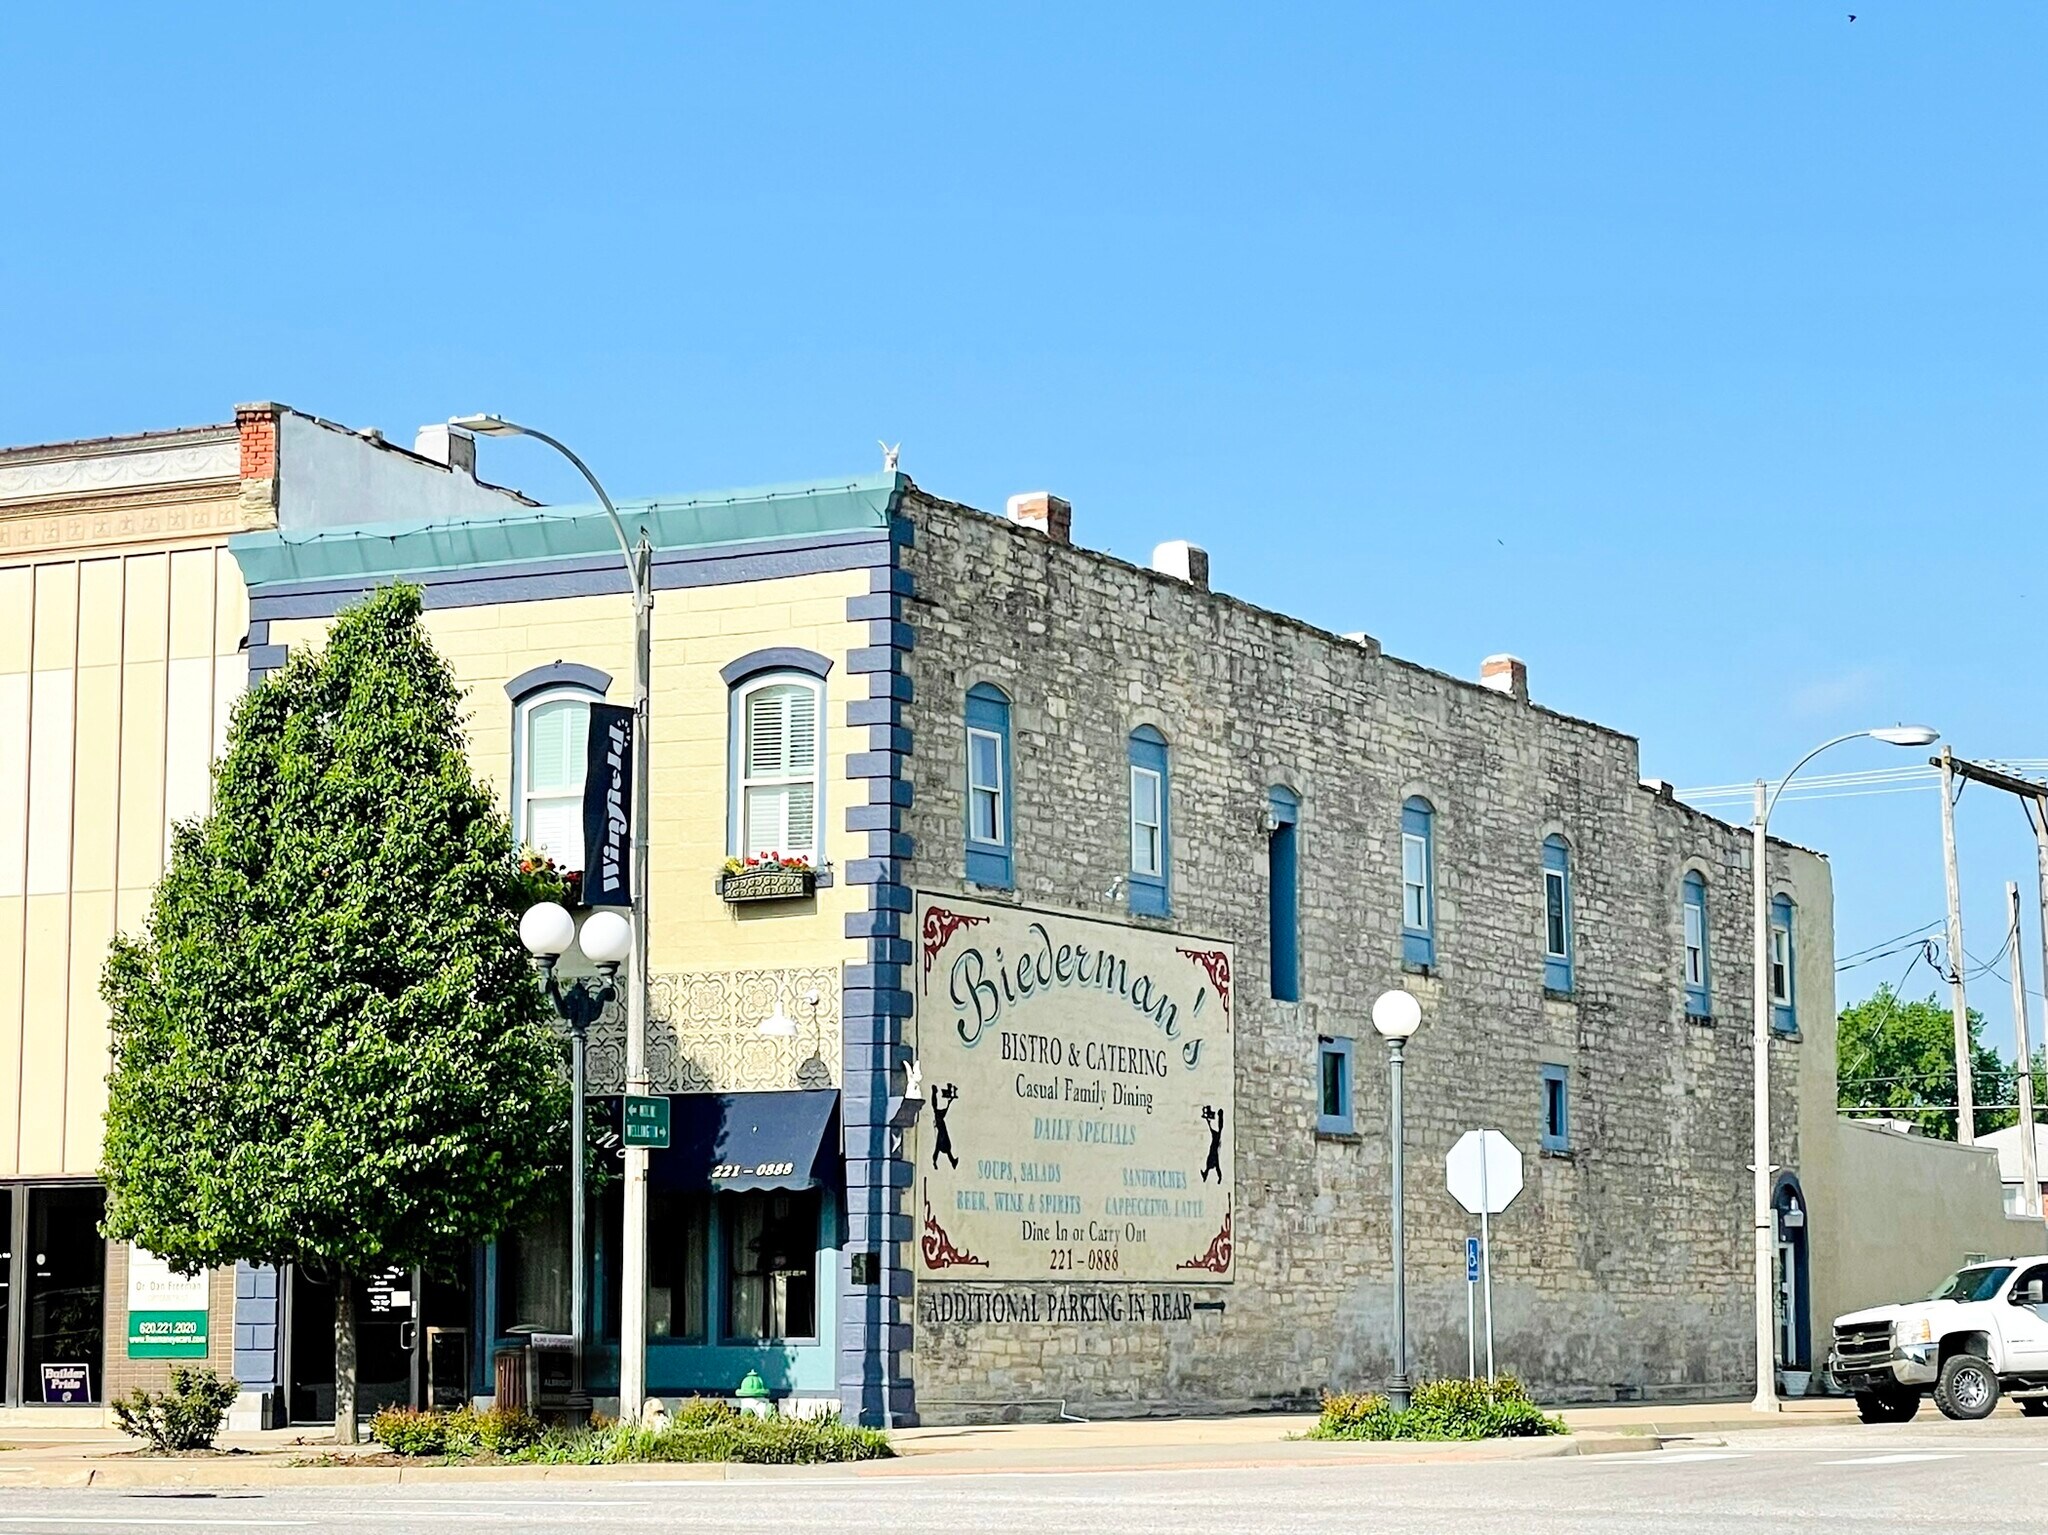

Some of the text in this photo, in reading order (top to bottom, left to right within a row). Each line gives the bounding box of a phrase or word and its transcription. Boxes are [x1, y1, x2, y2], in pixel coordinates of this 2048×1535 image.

[949, 921, 1207, 1069] Biederman's
[1000, 1031, 1168, 1078] BISTRO & CATERING
[1015, 1072, 1153, 1114] Casual Family Dining
[1033, 1116, 1137, 1146] DAILY SPECIALS
[977, 1159, 1062, 1183] SOUPS, SALADS
[1122, 1167, 1187, 1190] SANDWICHES
[956, 1190, 1082, 1215] BEER, WINE & SPIRITS
[1021, 1219, 1147, 1248] Dine In or Carry Out
[928, 1292, 1192, 1323] ADDITIONAL PARKING IN REAR
[45, 1368, 86, 1379] Builder
[51, 1379, 81, 1389] Pride
